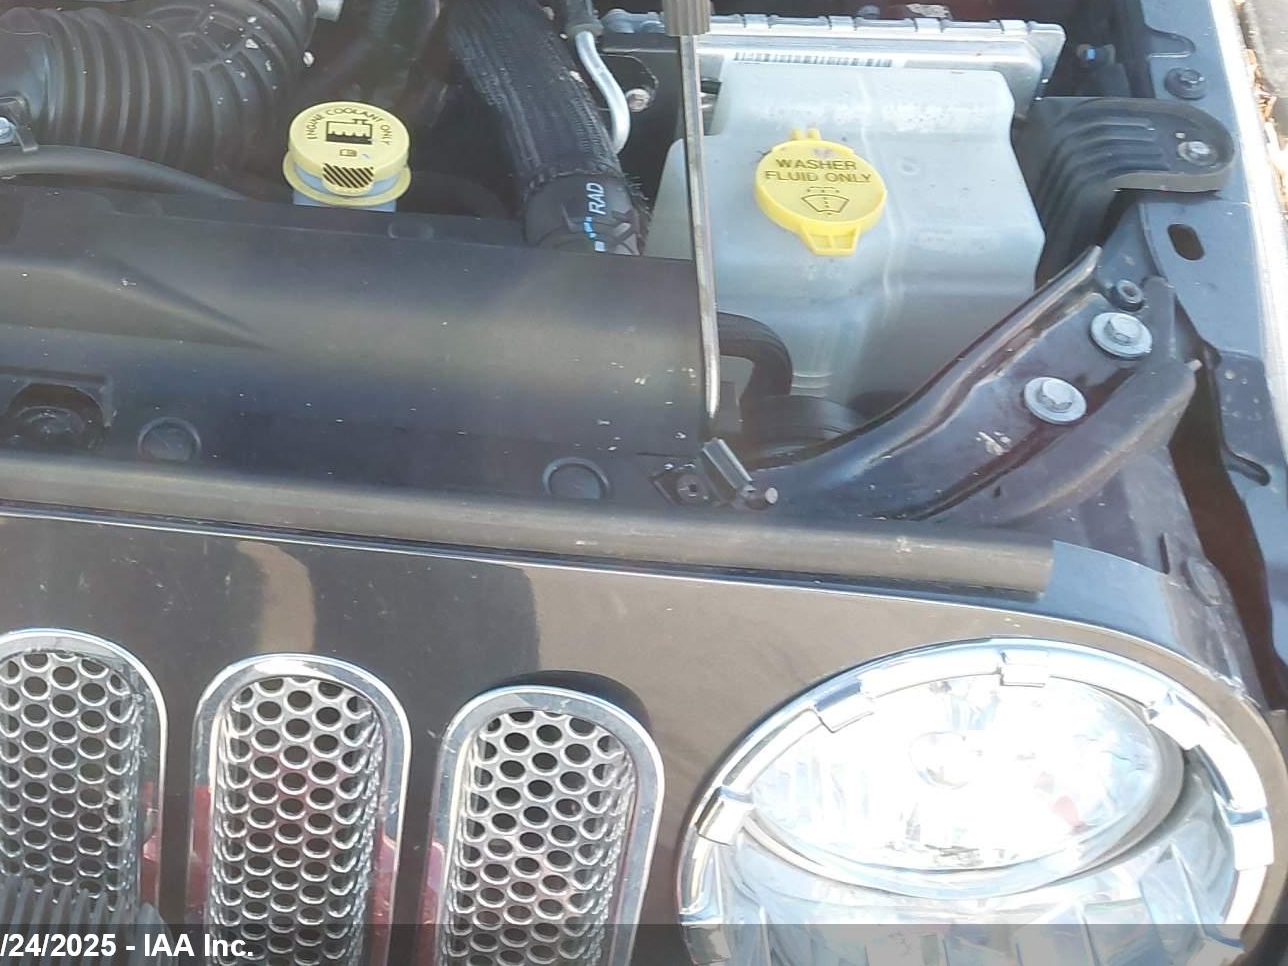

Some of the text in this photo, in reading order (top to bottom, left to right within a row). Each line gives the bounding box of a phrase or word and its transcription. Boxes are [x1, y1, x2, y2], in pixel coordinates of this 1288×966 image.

[306, 107, 393, 146] ENGINE COOLANT ONLY
[775, 158, 857, 171] WASHER
[764, 170, 872, 183] FLUID ONLY
[585, 181, 607, 215] RAD
